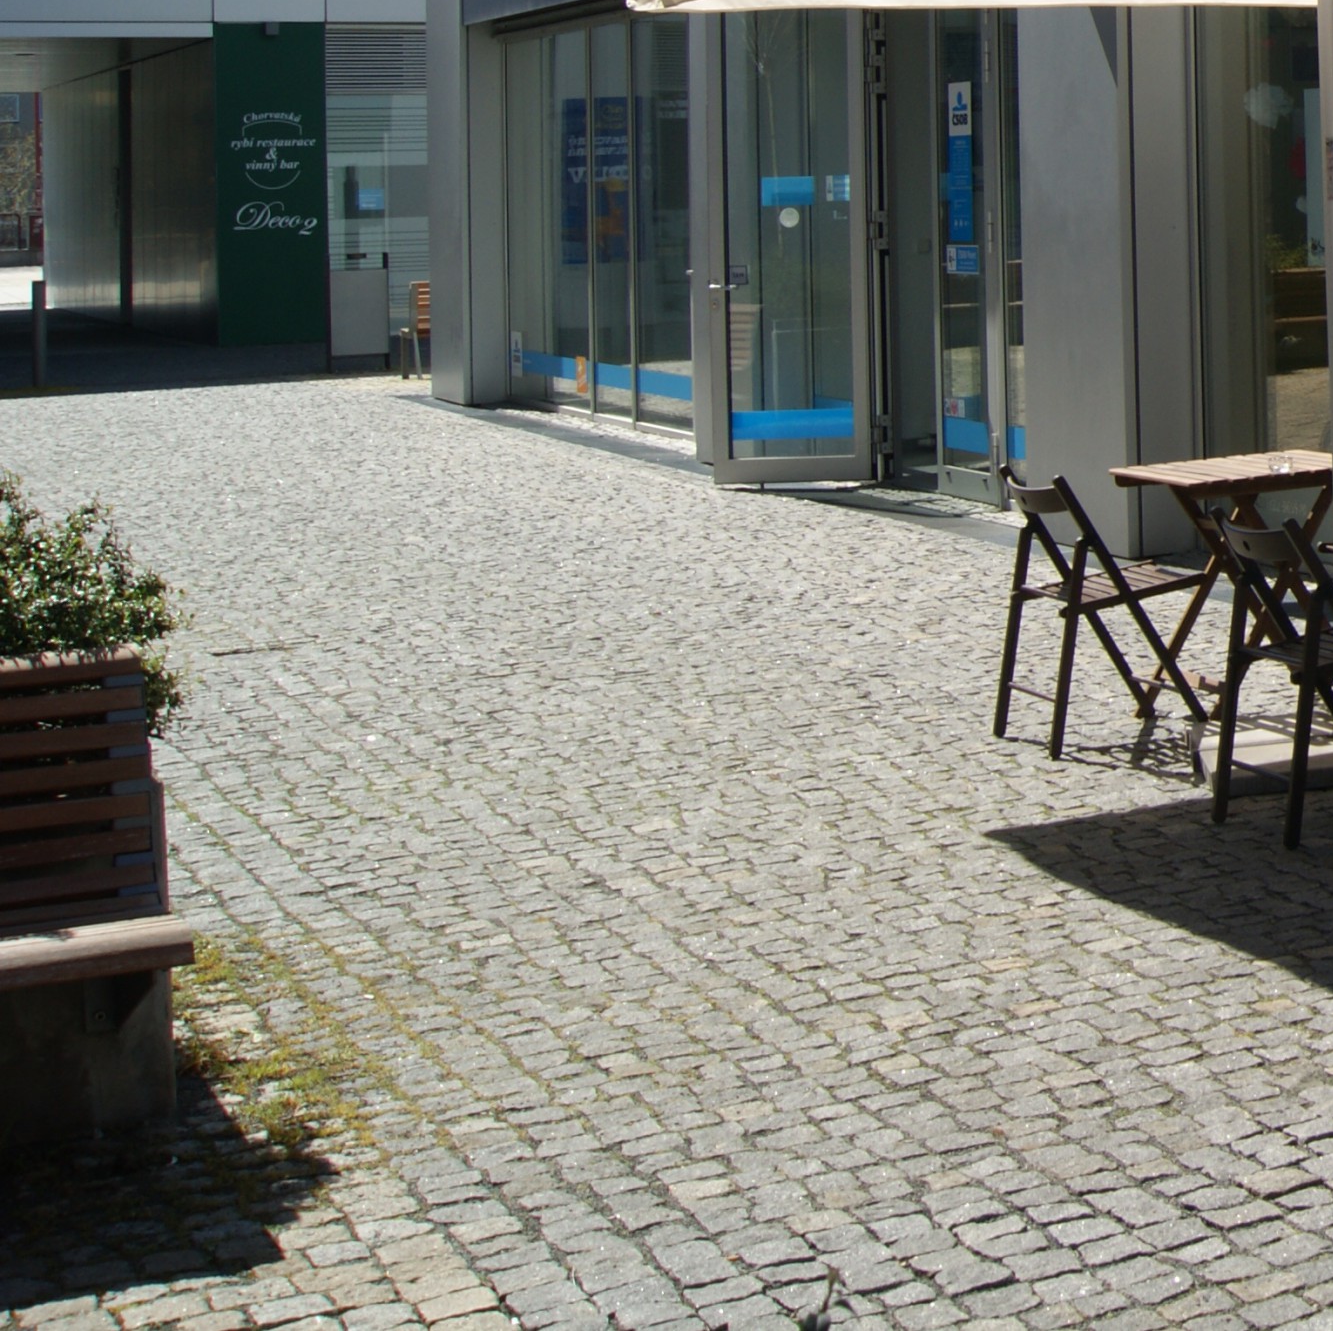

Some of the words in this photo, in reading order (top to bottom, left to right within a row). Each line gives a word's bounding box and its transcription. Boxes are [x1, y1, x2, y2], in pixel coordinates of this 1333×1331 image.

[242, 112, 302, 124] Chorvatská
[230, 137, 255, 150] rybí
[256, 138, 317, 148] restaurace
[264, 147, 278, 161] &
[279, 159, 300, 170] bar
